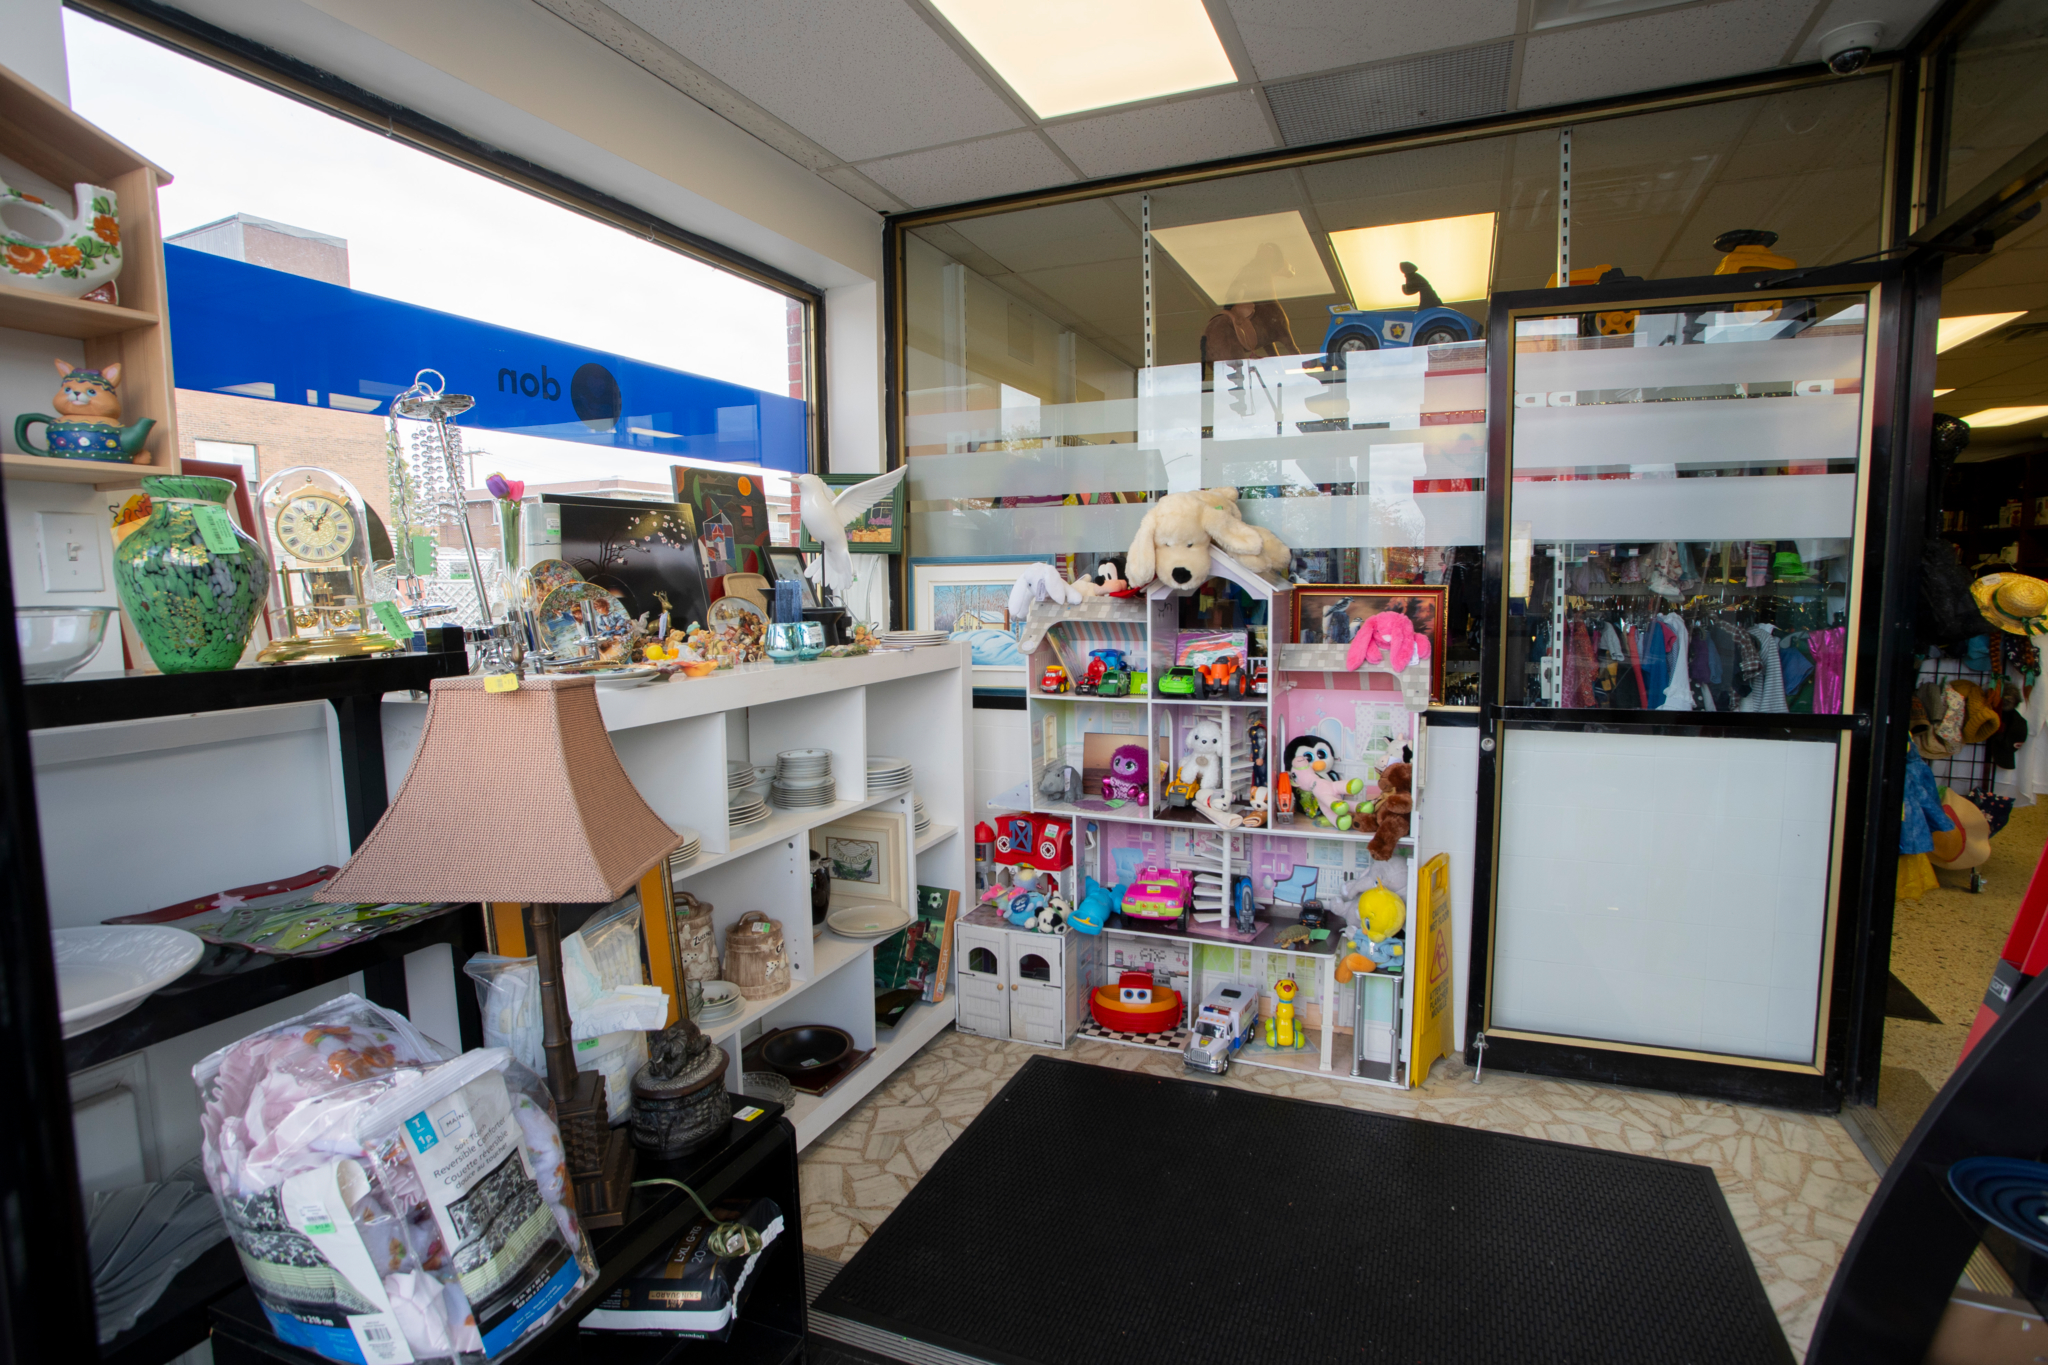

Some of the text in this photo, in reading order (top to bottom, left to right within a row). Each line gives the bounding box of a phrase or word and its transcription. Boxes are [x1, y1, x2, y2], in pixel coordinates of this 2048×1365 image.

[412, 1117, 420, 1128] T
[454, 1138, 470, 1152] Soft
[470, 1123, 487, 1142] Touch
[433, 1117, 506, 1178] Reversible Comforter
[444, 1129, 509, 1186] Couette réversible
[455, 1142, 508, 1189] douce au toucher
[674, 1225, 701, 1263] L-XL G-TG
[691, 1250, 706, 1264] 20
